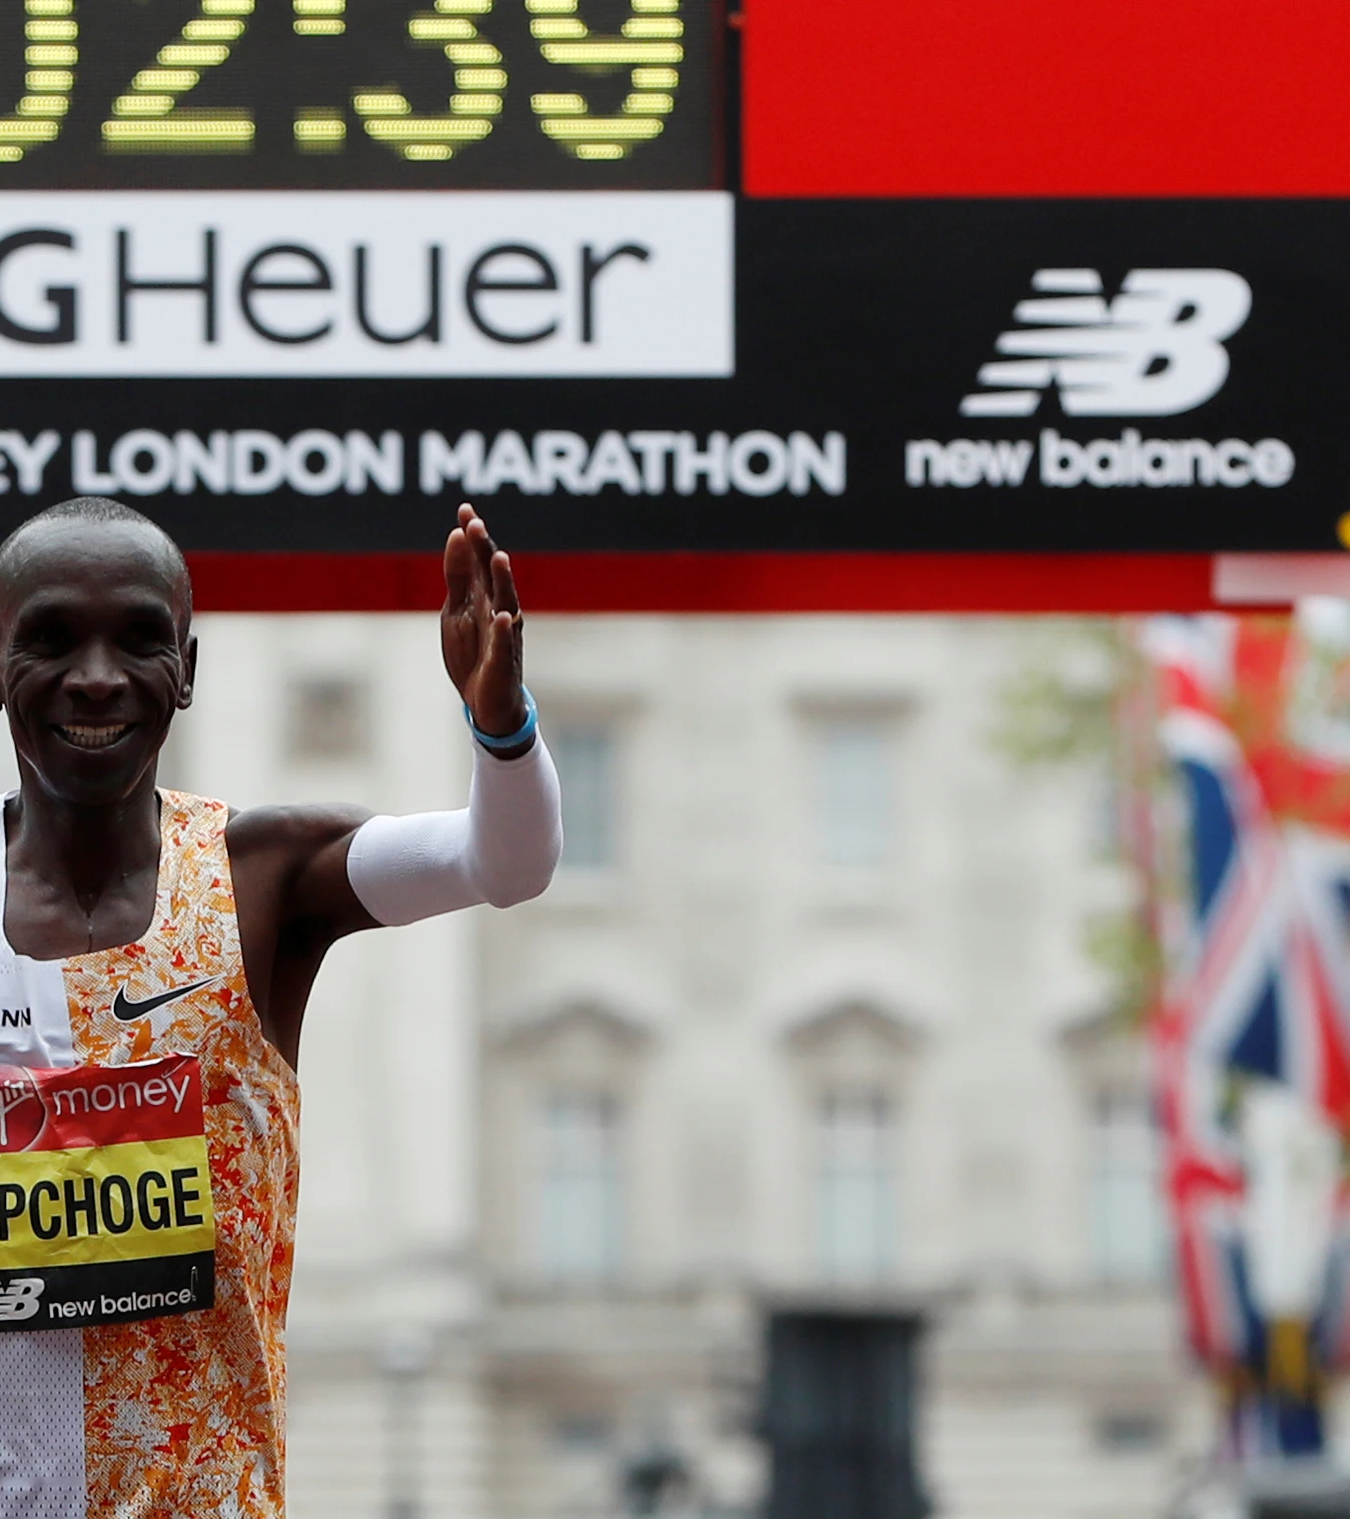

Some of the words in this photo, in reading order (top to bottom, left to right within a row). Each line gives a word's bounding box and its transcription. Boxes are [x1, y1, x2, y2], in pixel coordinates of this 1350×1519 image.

[72, 430, 403, 495] LONDON
[420, 430, 846, 495] MARATHON
[906, 438, 1034, 487] new
[1040, 428, 1296, 487] balance
[0, 1006, 32, 1028] NN
[53, 1074, 190, 1115] money
[48, 1299, 96, 1319] new
[100, 1287, 192, 1315] balance
